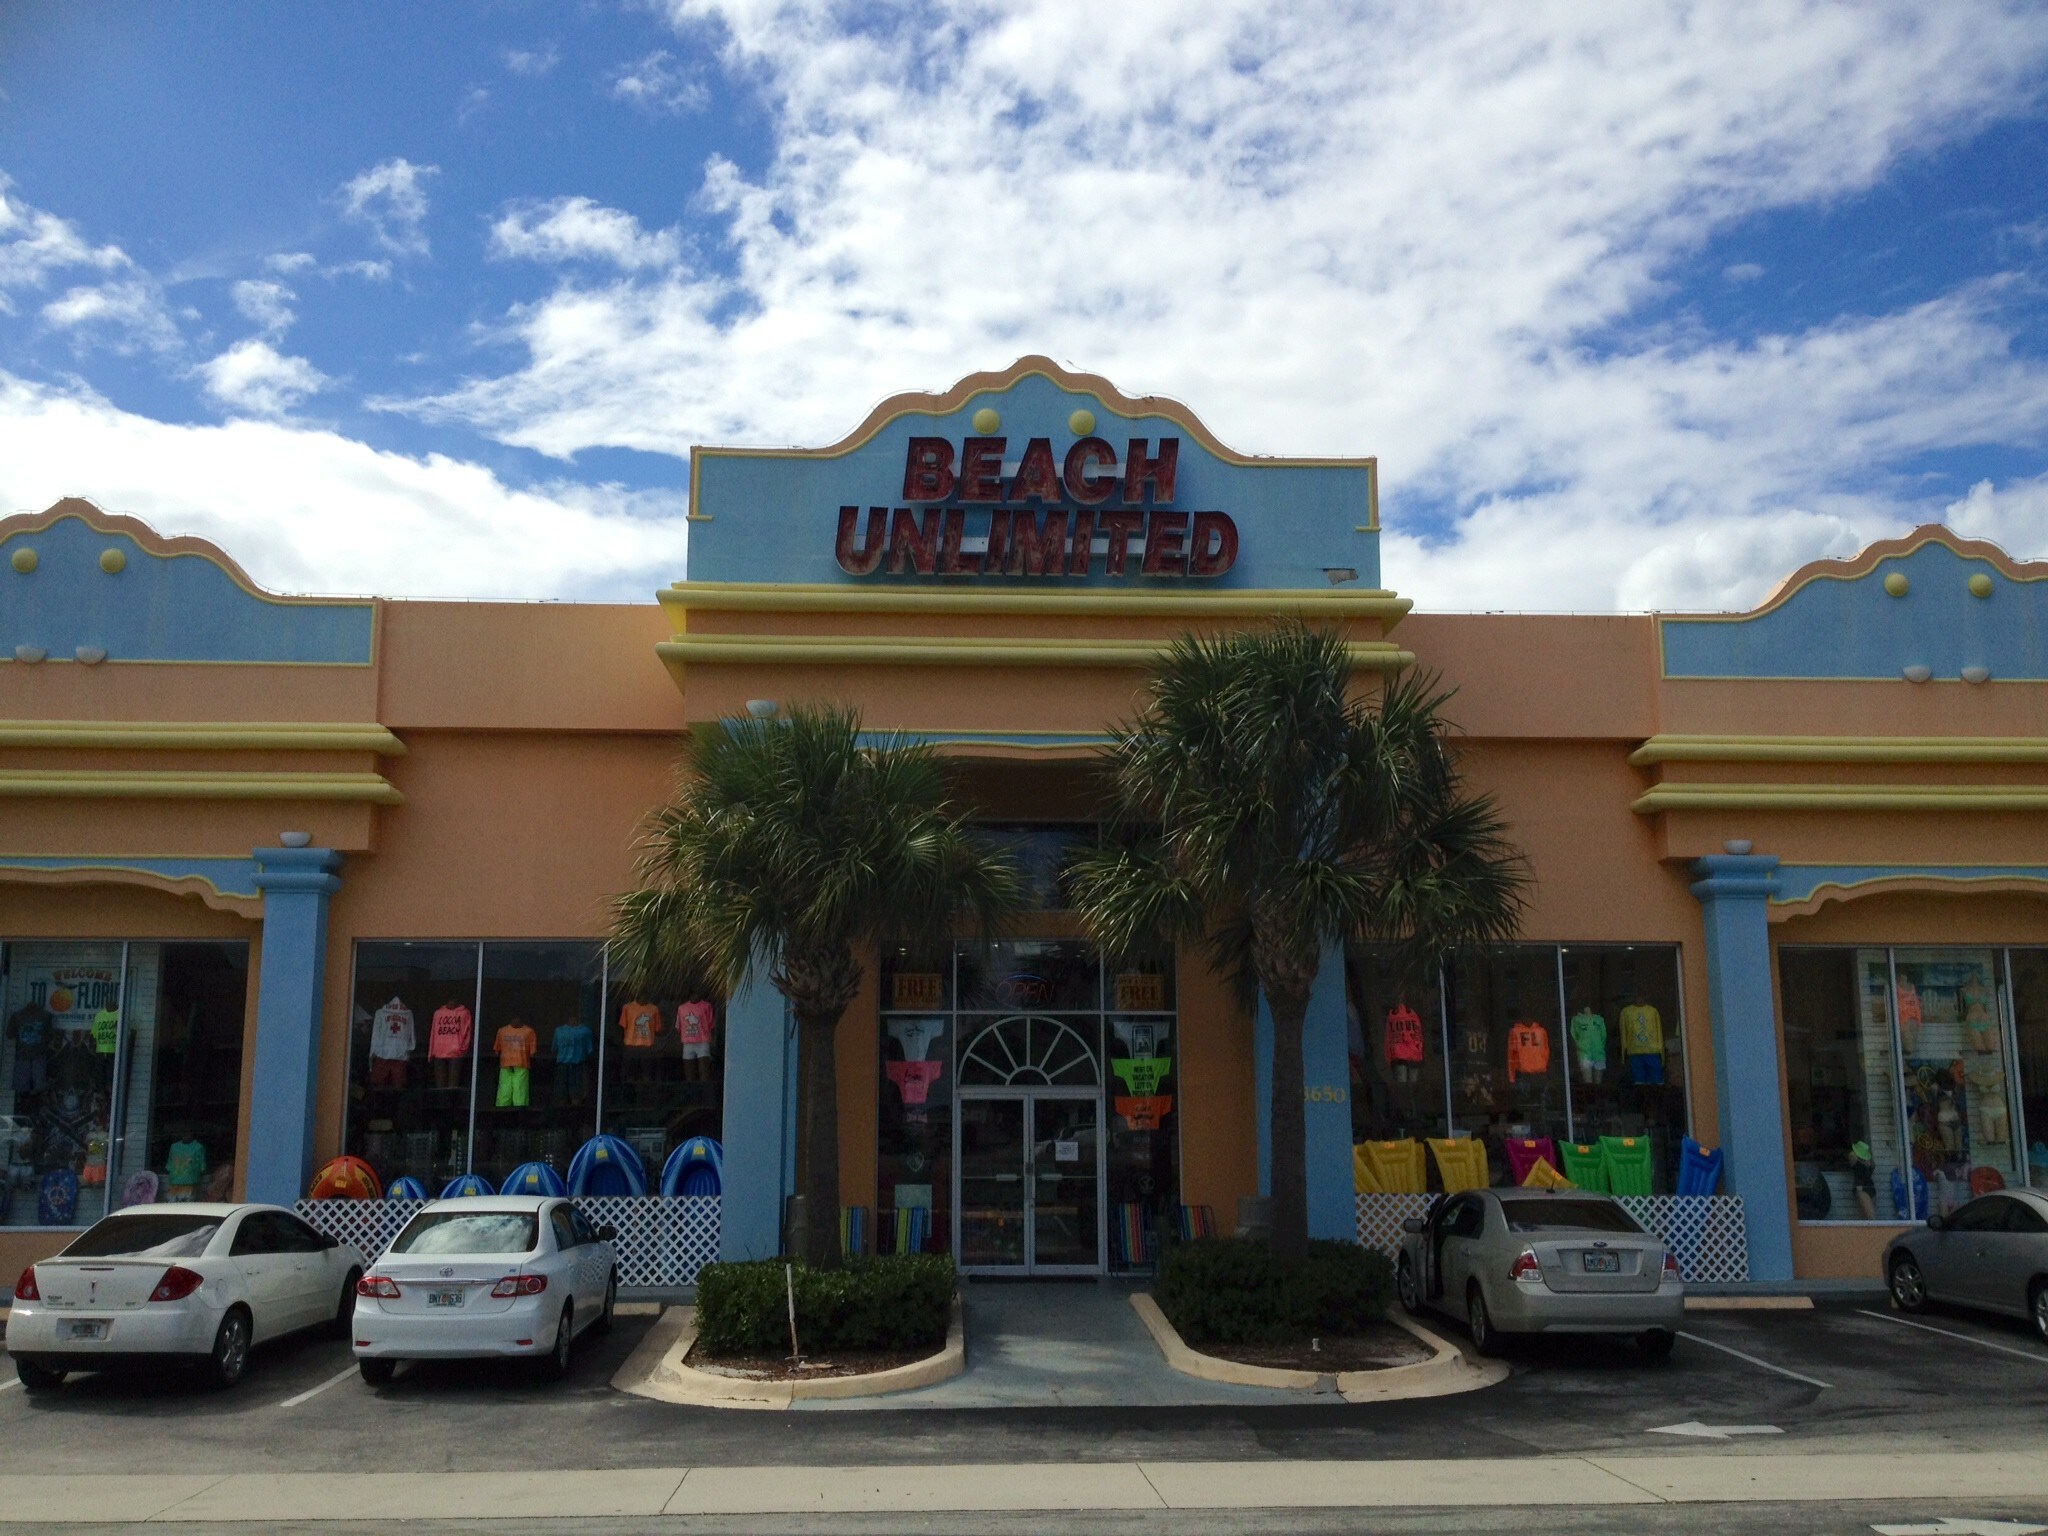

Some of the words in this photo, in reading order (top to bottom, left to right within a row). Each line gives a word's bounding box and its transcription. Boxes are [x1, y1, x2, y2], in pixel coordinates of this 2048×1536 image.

[903, 437, 1179, 504] BEACH
[835, 506, 1239, 577] UNLIMITED
[53, 967, 112, 981] WELCOME
[30, 981, 46, 1009] TO
[898, 978, 937, 997] FREE
[995, 980, 1055, 1002] OPEN
[1120, 985, 1159, 1001] FREE
[439, 1016, 461, 1026] COCOA
[438, 1027, 460, 1036] BEACH
[1520, 1031, 1539, 1046] FL
